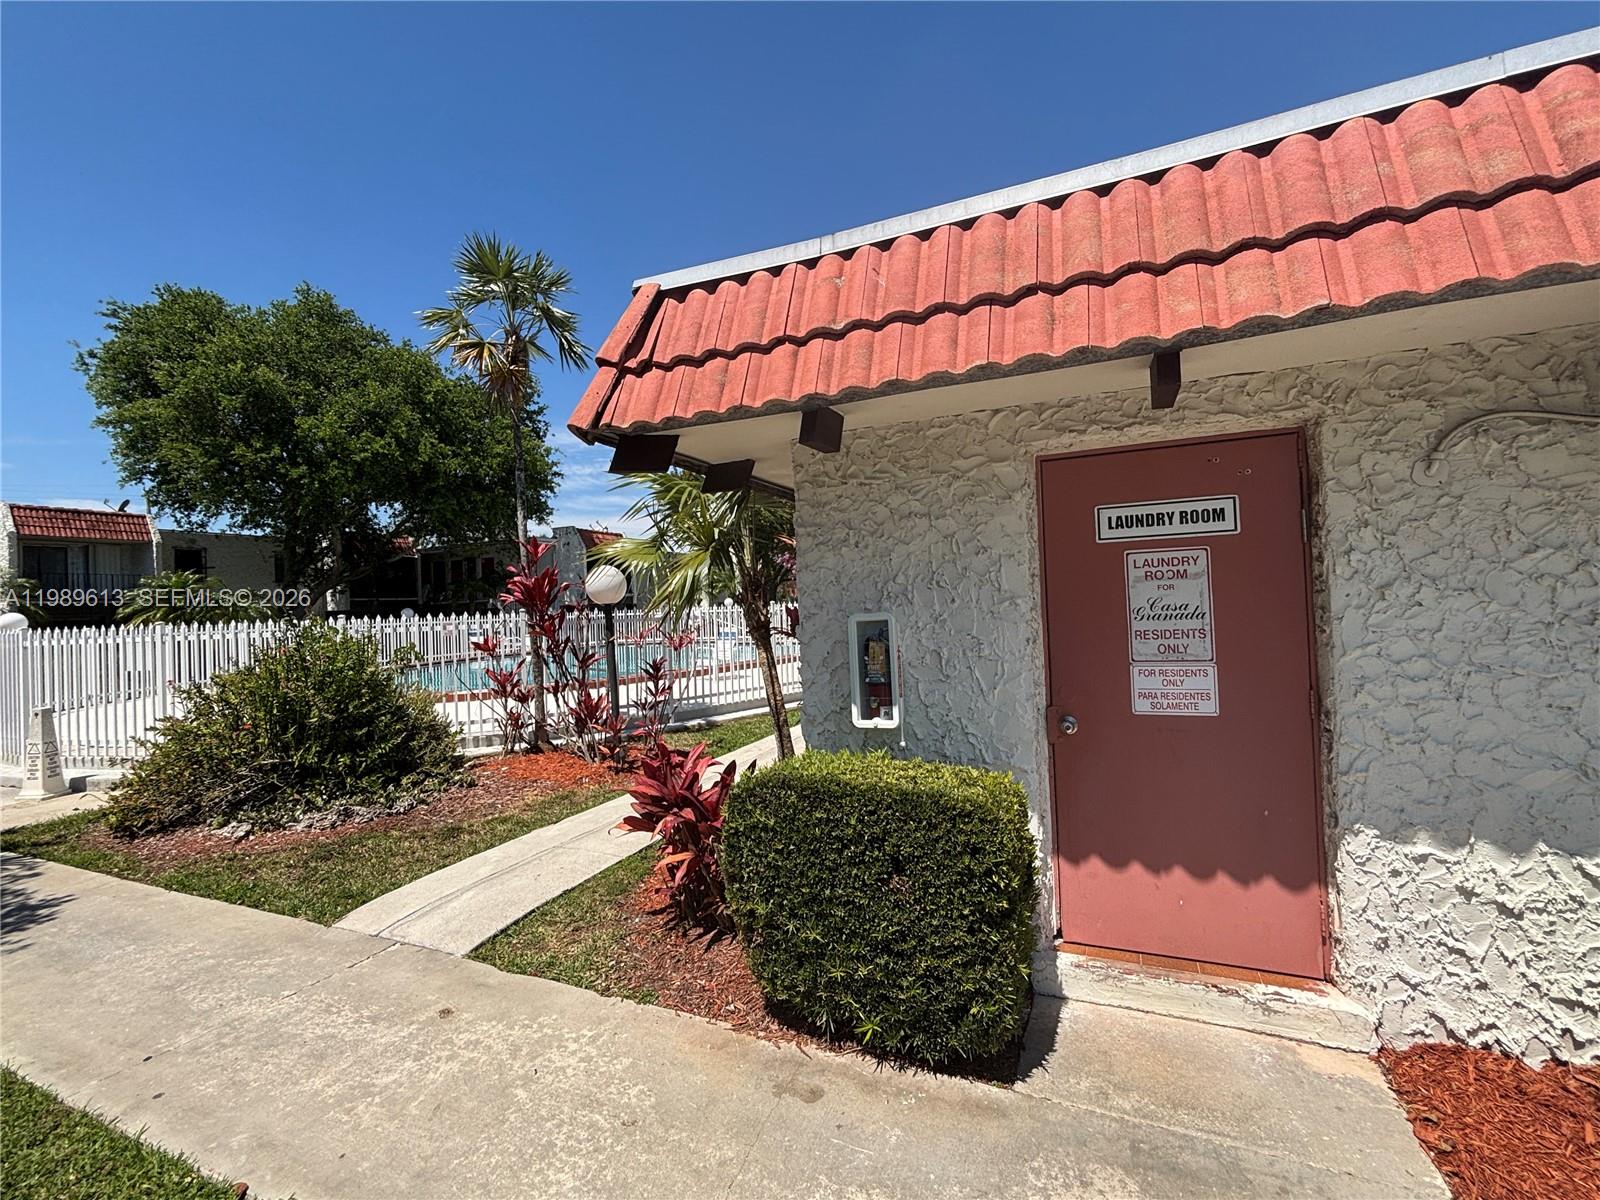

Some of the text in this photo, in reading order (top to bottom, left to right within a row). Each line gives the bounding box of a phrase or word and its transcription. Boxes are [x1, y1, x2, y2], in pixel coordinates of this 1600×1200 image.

[1107, 507, 1226, 530] LAUNDRY ROOM
[1133, 556, 1200, 569] LAUNDRY
[1144, 569, 1188, 581] ROOM
[1146, 596, 1190, 613] Casa
[1132, 605, 1207, 621] Granada
[1134, 628, 1207, 640] RESIDENTS
[1157, 643, 1189, 655] ONLY
[1138, 668, 1209, 678] FOR RESIDENTS
[1161, 679, 1185, 687] ONLY
[1138, 691, 1211, 701] PARA RESIDENTES
[1150, 702, 1200, 711] SOLAMENTE
